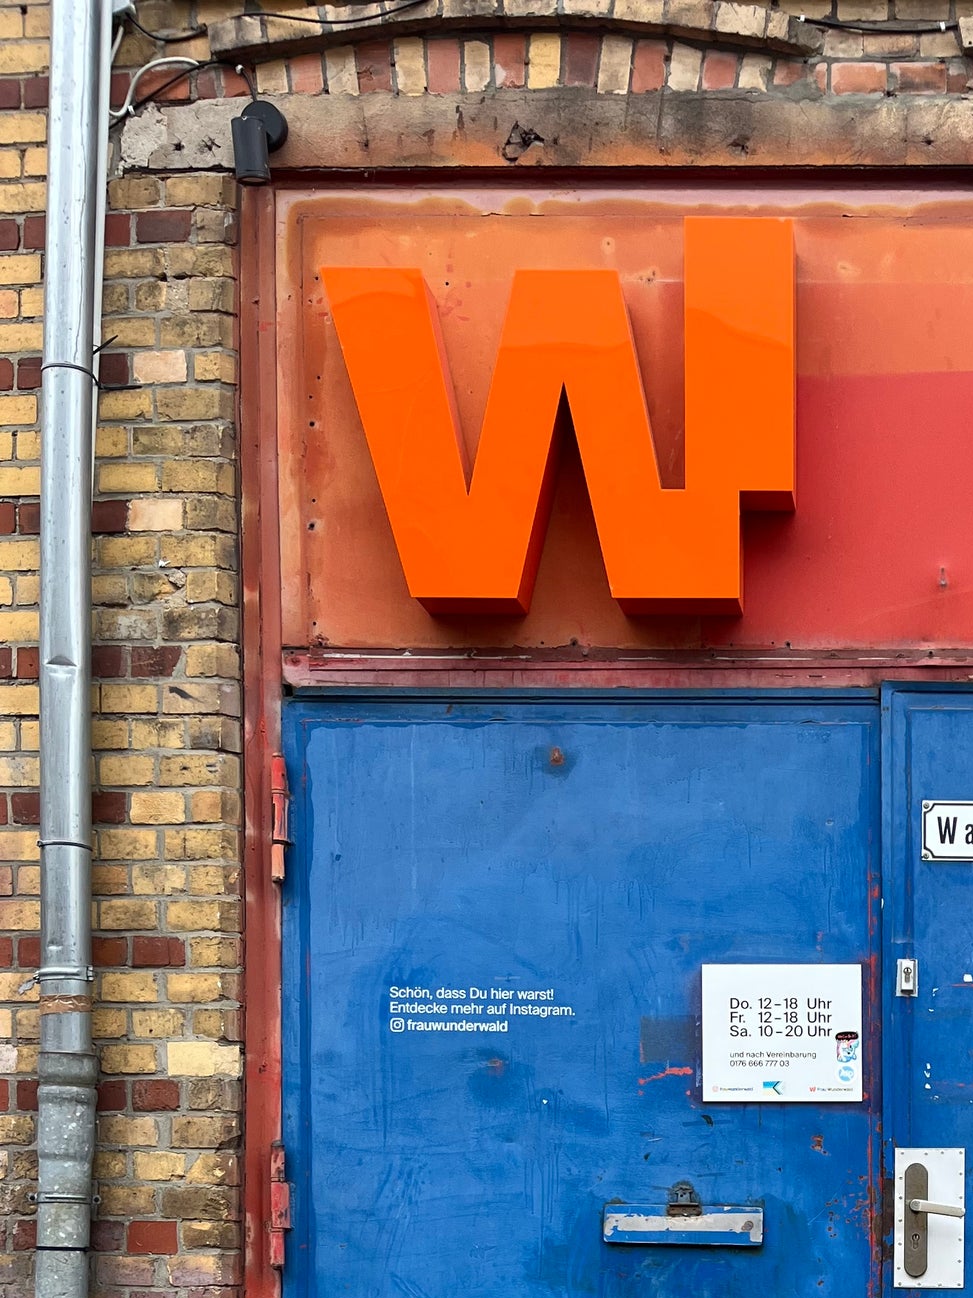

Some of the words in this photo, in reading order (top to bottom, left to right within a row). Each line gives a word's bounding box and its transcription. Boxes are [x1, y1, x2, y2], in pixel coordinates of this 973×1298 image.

[389, 986, 433, 1000] Schön,
[436, 987, 467, 999] dass
[469, 987, 488, 999] Du
[490, 988, 515, 1000] hier
[517, 988, 554, 1000] warst!
[389, 1001, 448, 1014] Entdecke
[450, 1003, 485, 1015] mehr
[486, 1002, 507, 1015] auf
[509, 1003, 576, 1018] Instagram.
[729, 997, 753, 1010] Do.
[807, 997, 833, 1010] Uhr
[729, 1011, 746, 1024] Fr.
[807, 1011, 833, 1024] Uhr
[406, 1019, 509, 1032] frauwunderwald
[729, 1025, 752, 1038] Sa.
[807, 1025, 833, 1038] Uhr
[729, 1051, 745, 1059] und
[746, 1051, 765, 1059] nach
[766, 1051, 817, 1061] Vereinbarung
[729, 1059, 747, 1068] 0176
[765, 1059, 778, 1068] 777
[779, 1059, 790, 1068] 03
